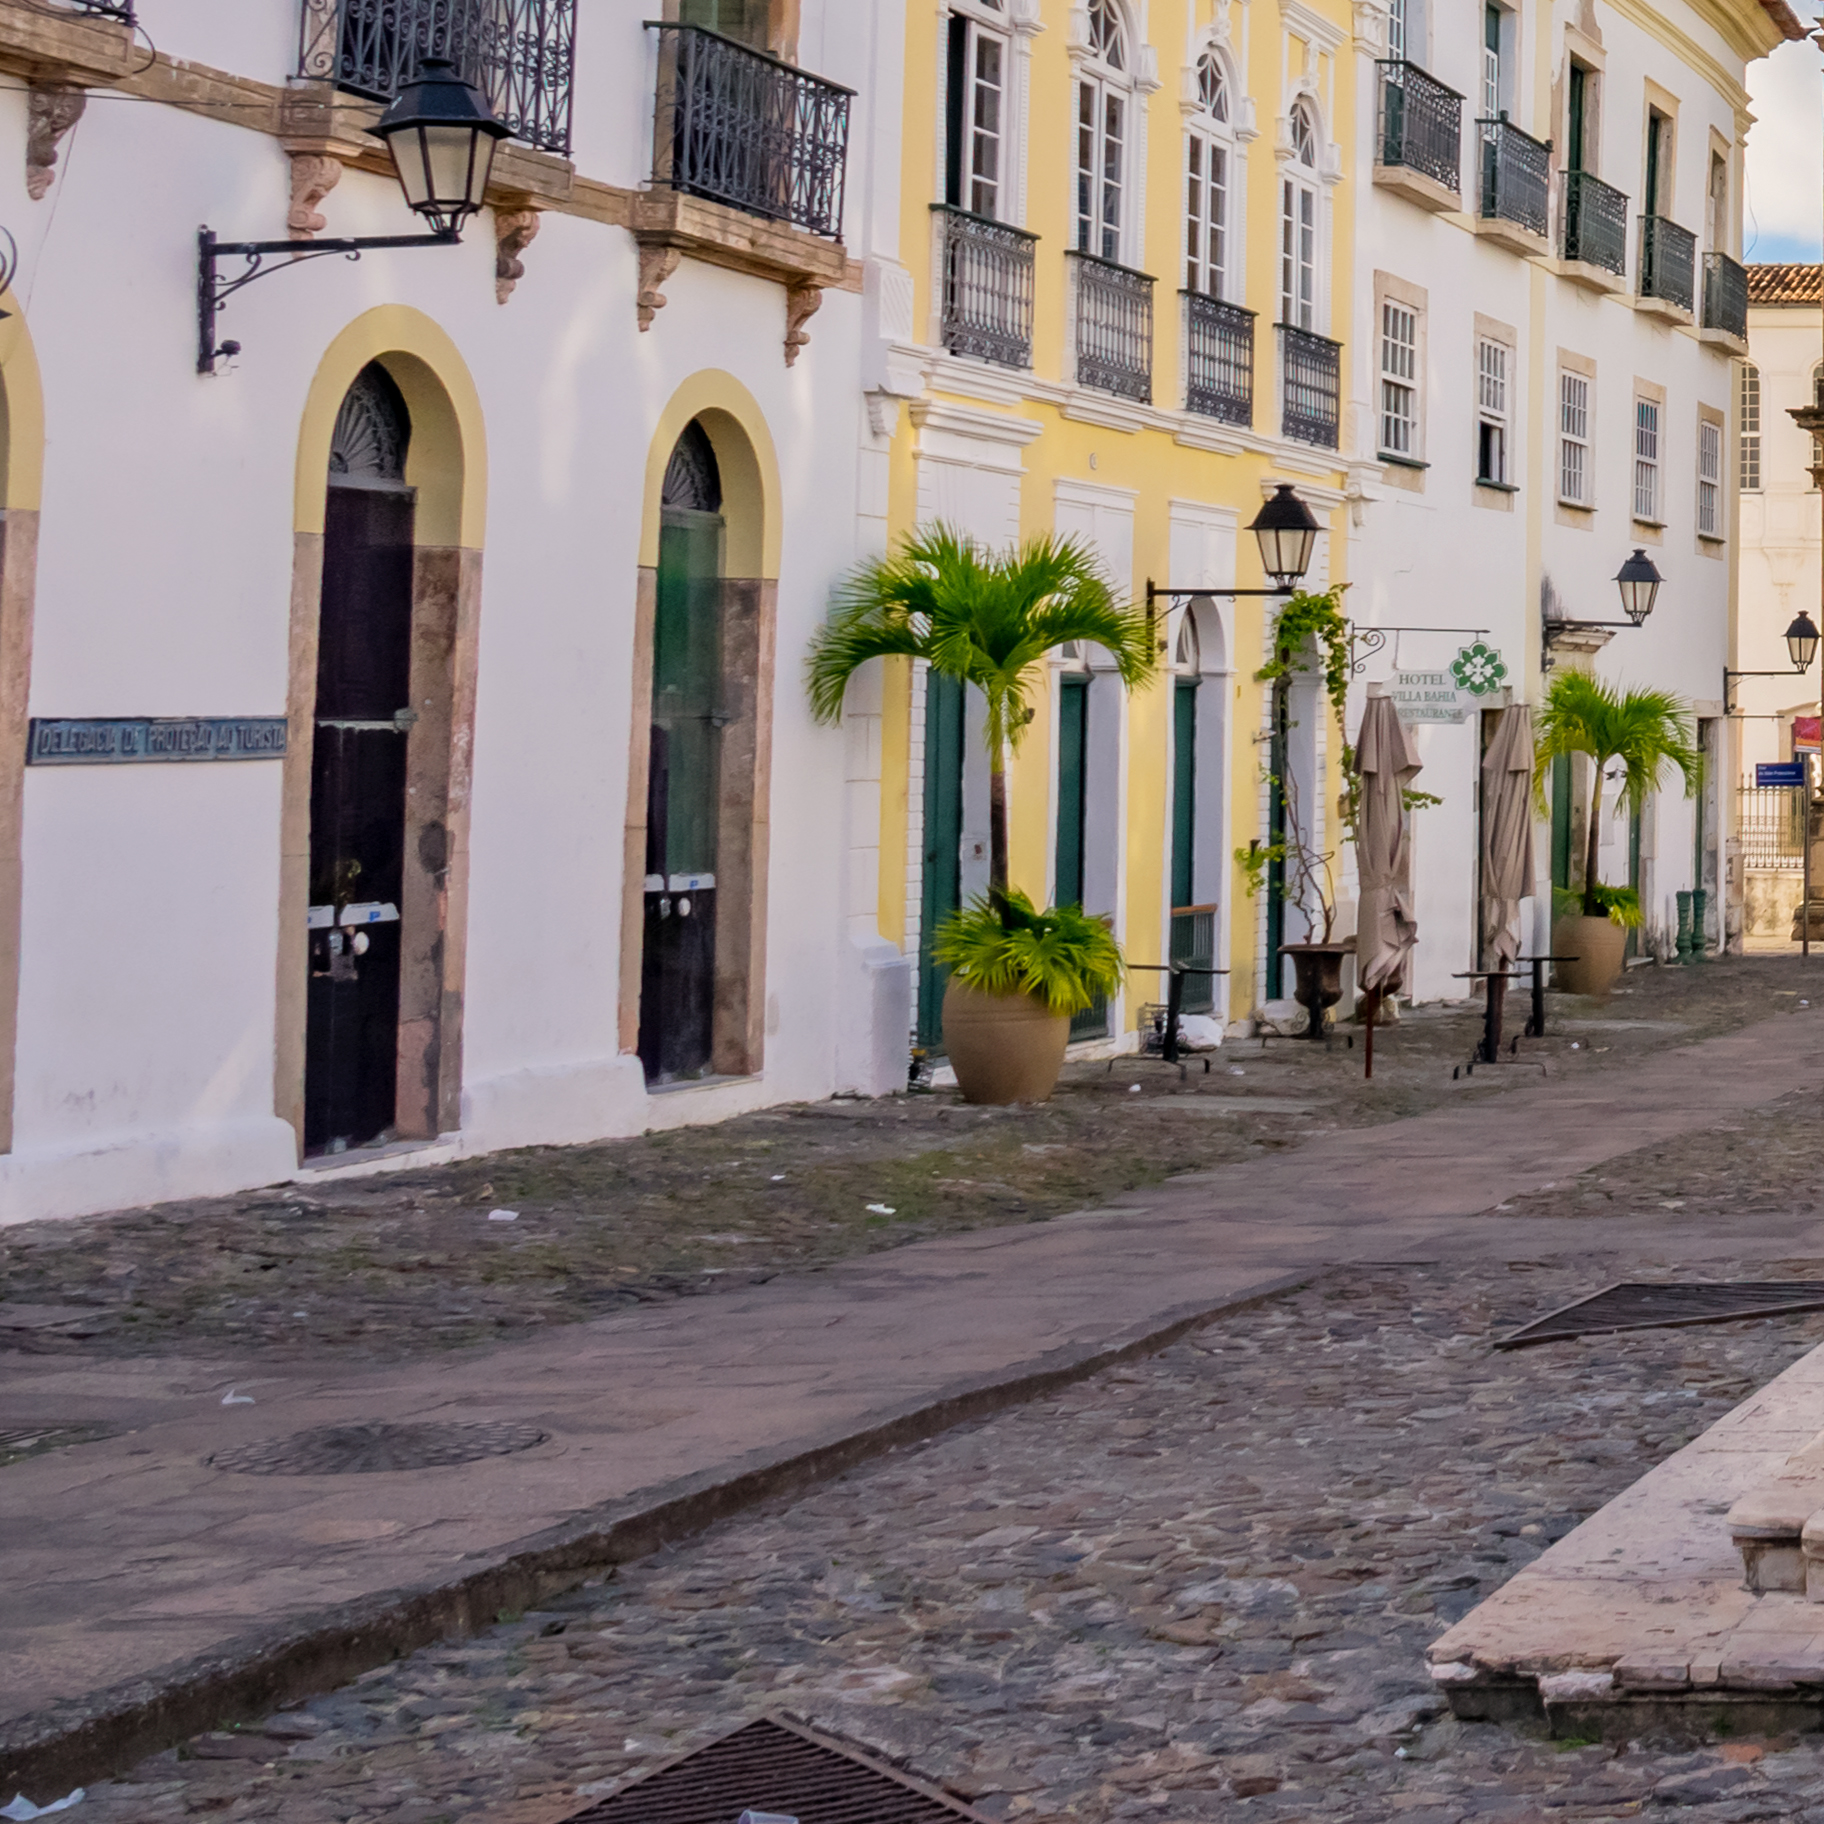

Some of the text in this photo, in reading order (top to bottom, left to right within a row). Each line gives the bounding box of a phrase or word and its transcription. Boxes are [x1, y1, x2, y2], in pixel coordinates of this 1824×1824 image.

[1399, 674, 1446, 685] HOTEL
[1392, 691, 1457, 703] VILLA BAHIA
[38, 726, 115, 753] DELEGACIA
[121, 726, 140, 753] DE
[236, 726, 286, 751] TURISTA
